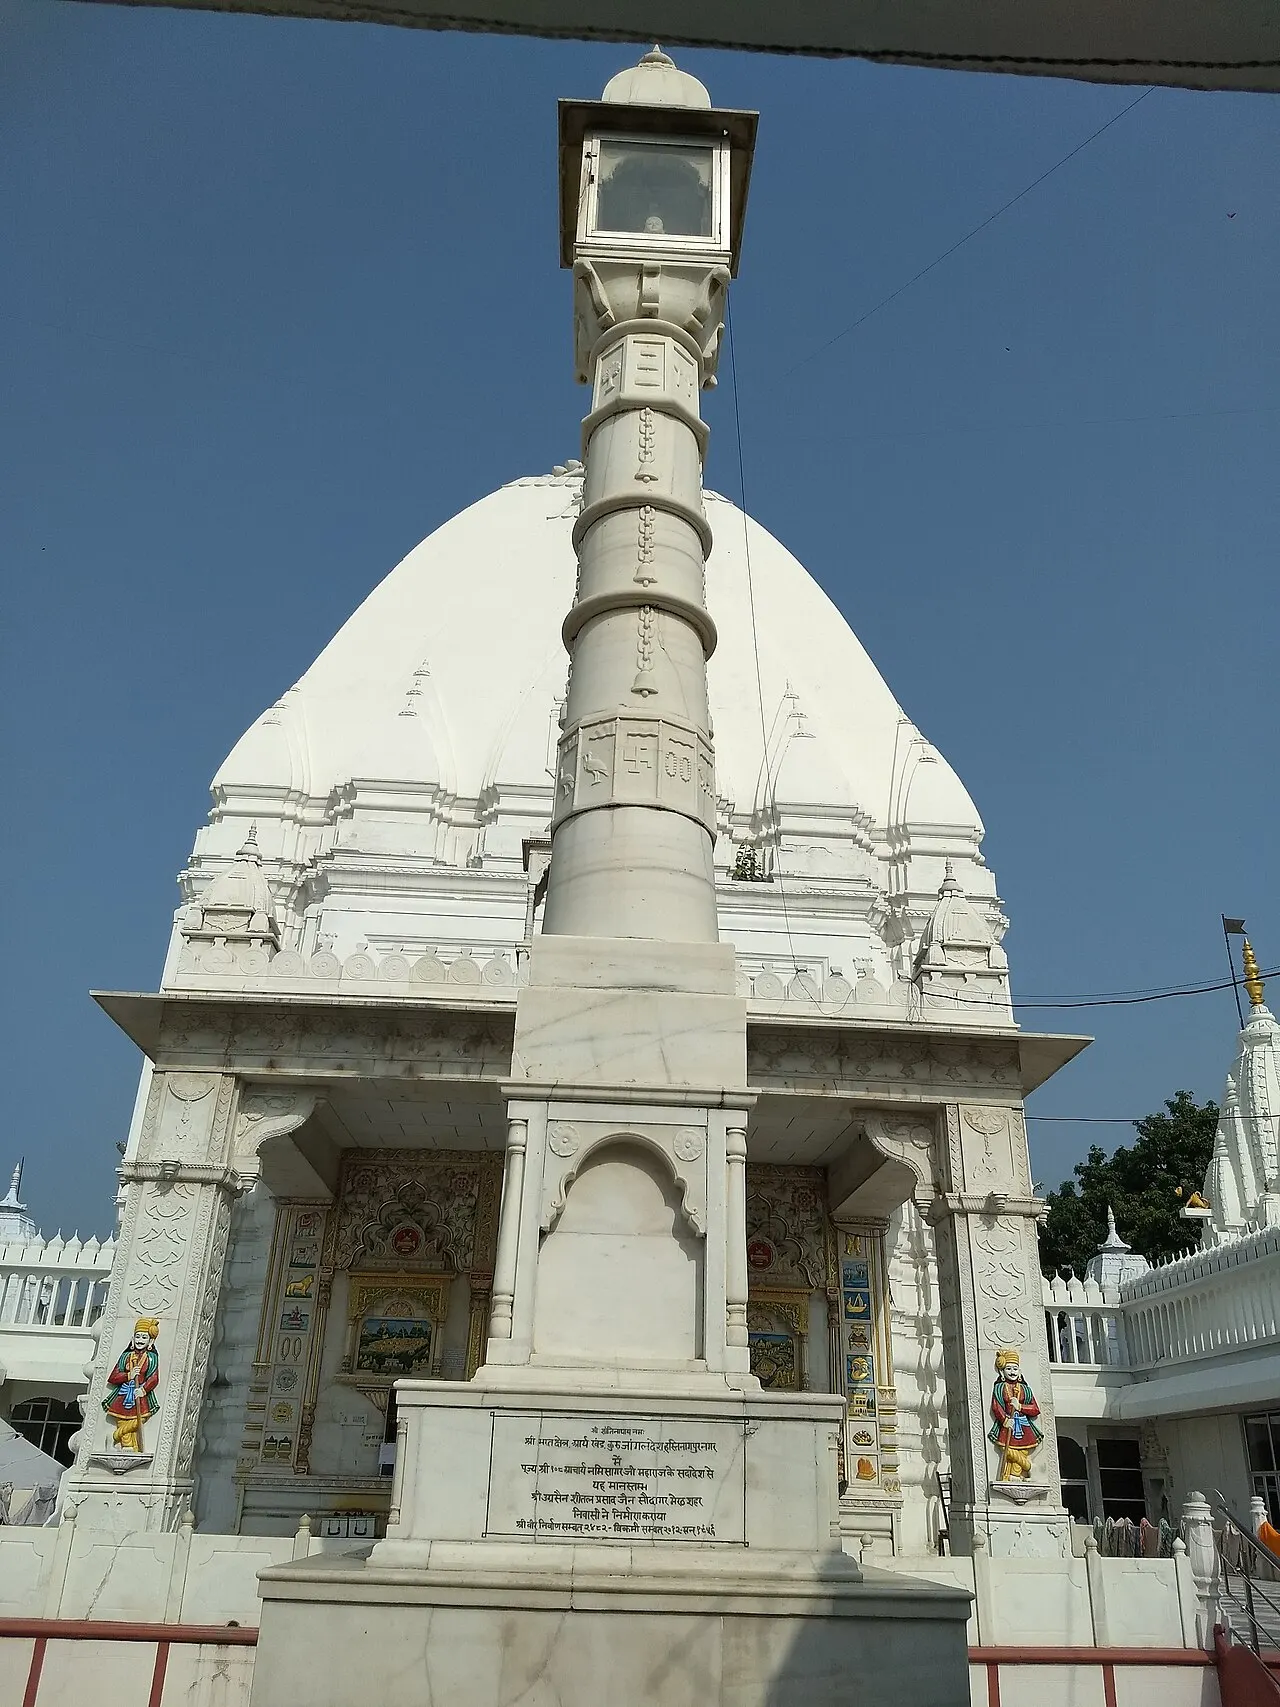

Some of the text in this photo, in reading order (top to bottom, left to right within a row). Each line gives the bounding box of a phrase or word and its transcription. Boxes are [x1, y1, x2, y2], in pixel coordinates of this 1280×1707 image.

[525, 1435, 536, 1445] श्री
[572, 1436, 588, 1448] आर्य
[612, 1454, 622, 1466] में
[521, 1464, 537, 1475] पूज्य
[539, 1462, 550, 1474] श्री
[551, 1465, 563, 1473] १०८
[564, 1462, 586, 1475] आचार्य
[637, 1468, 666, 1478] महाराज
[666, 1465, 675, 1477] के
[705, 1466, 714, 1479] से
[593, 1481, 605, 1492] यह
[531, 1490, 542, 1501] श्री
[570, 1492, 594, 1504] शीतल
[595, 1495, 616, 1505] प्रसाद
[618, 1493, 636, 1505] जैन
[637, 1492, 669, 1506] सौदागर
[686, 1497, 703, 1507] शहर
[572, 1506, 666, 1521] निवासी ने निर्माण कराया
[516, 1518, 526, 1529] श्री
[527, 1519, 537, 1530] वीर
[538, 1518, 561, 1530] निर्वाण
